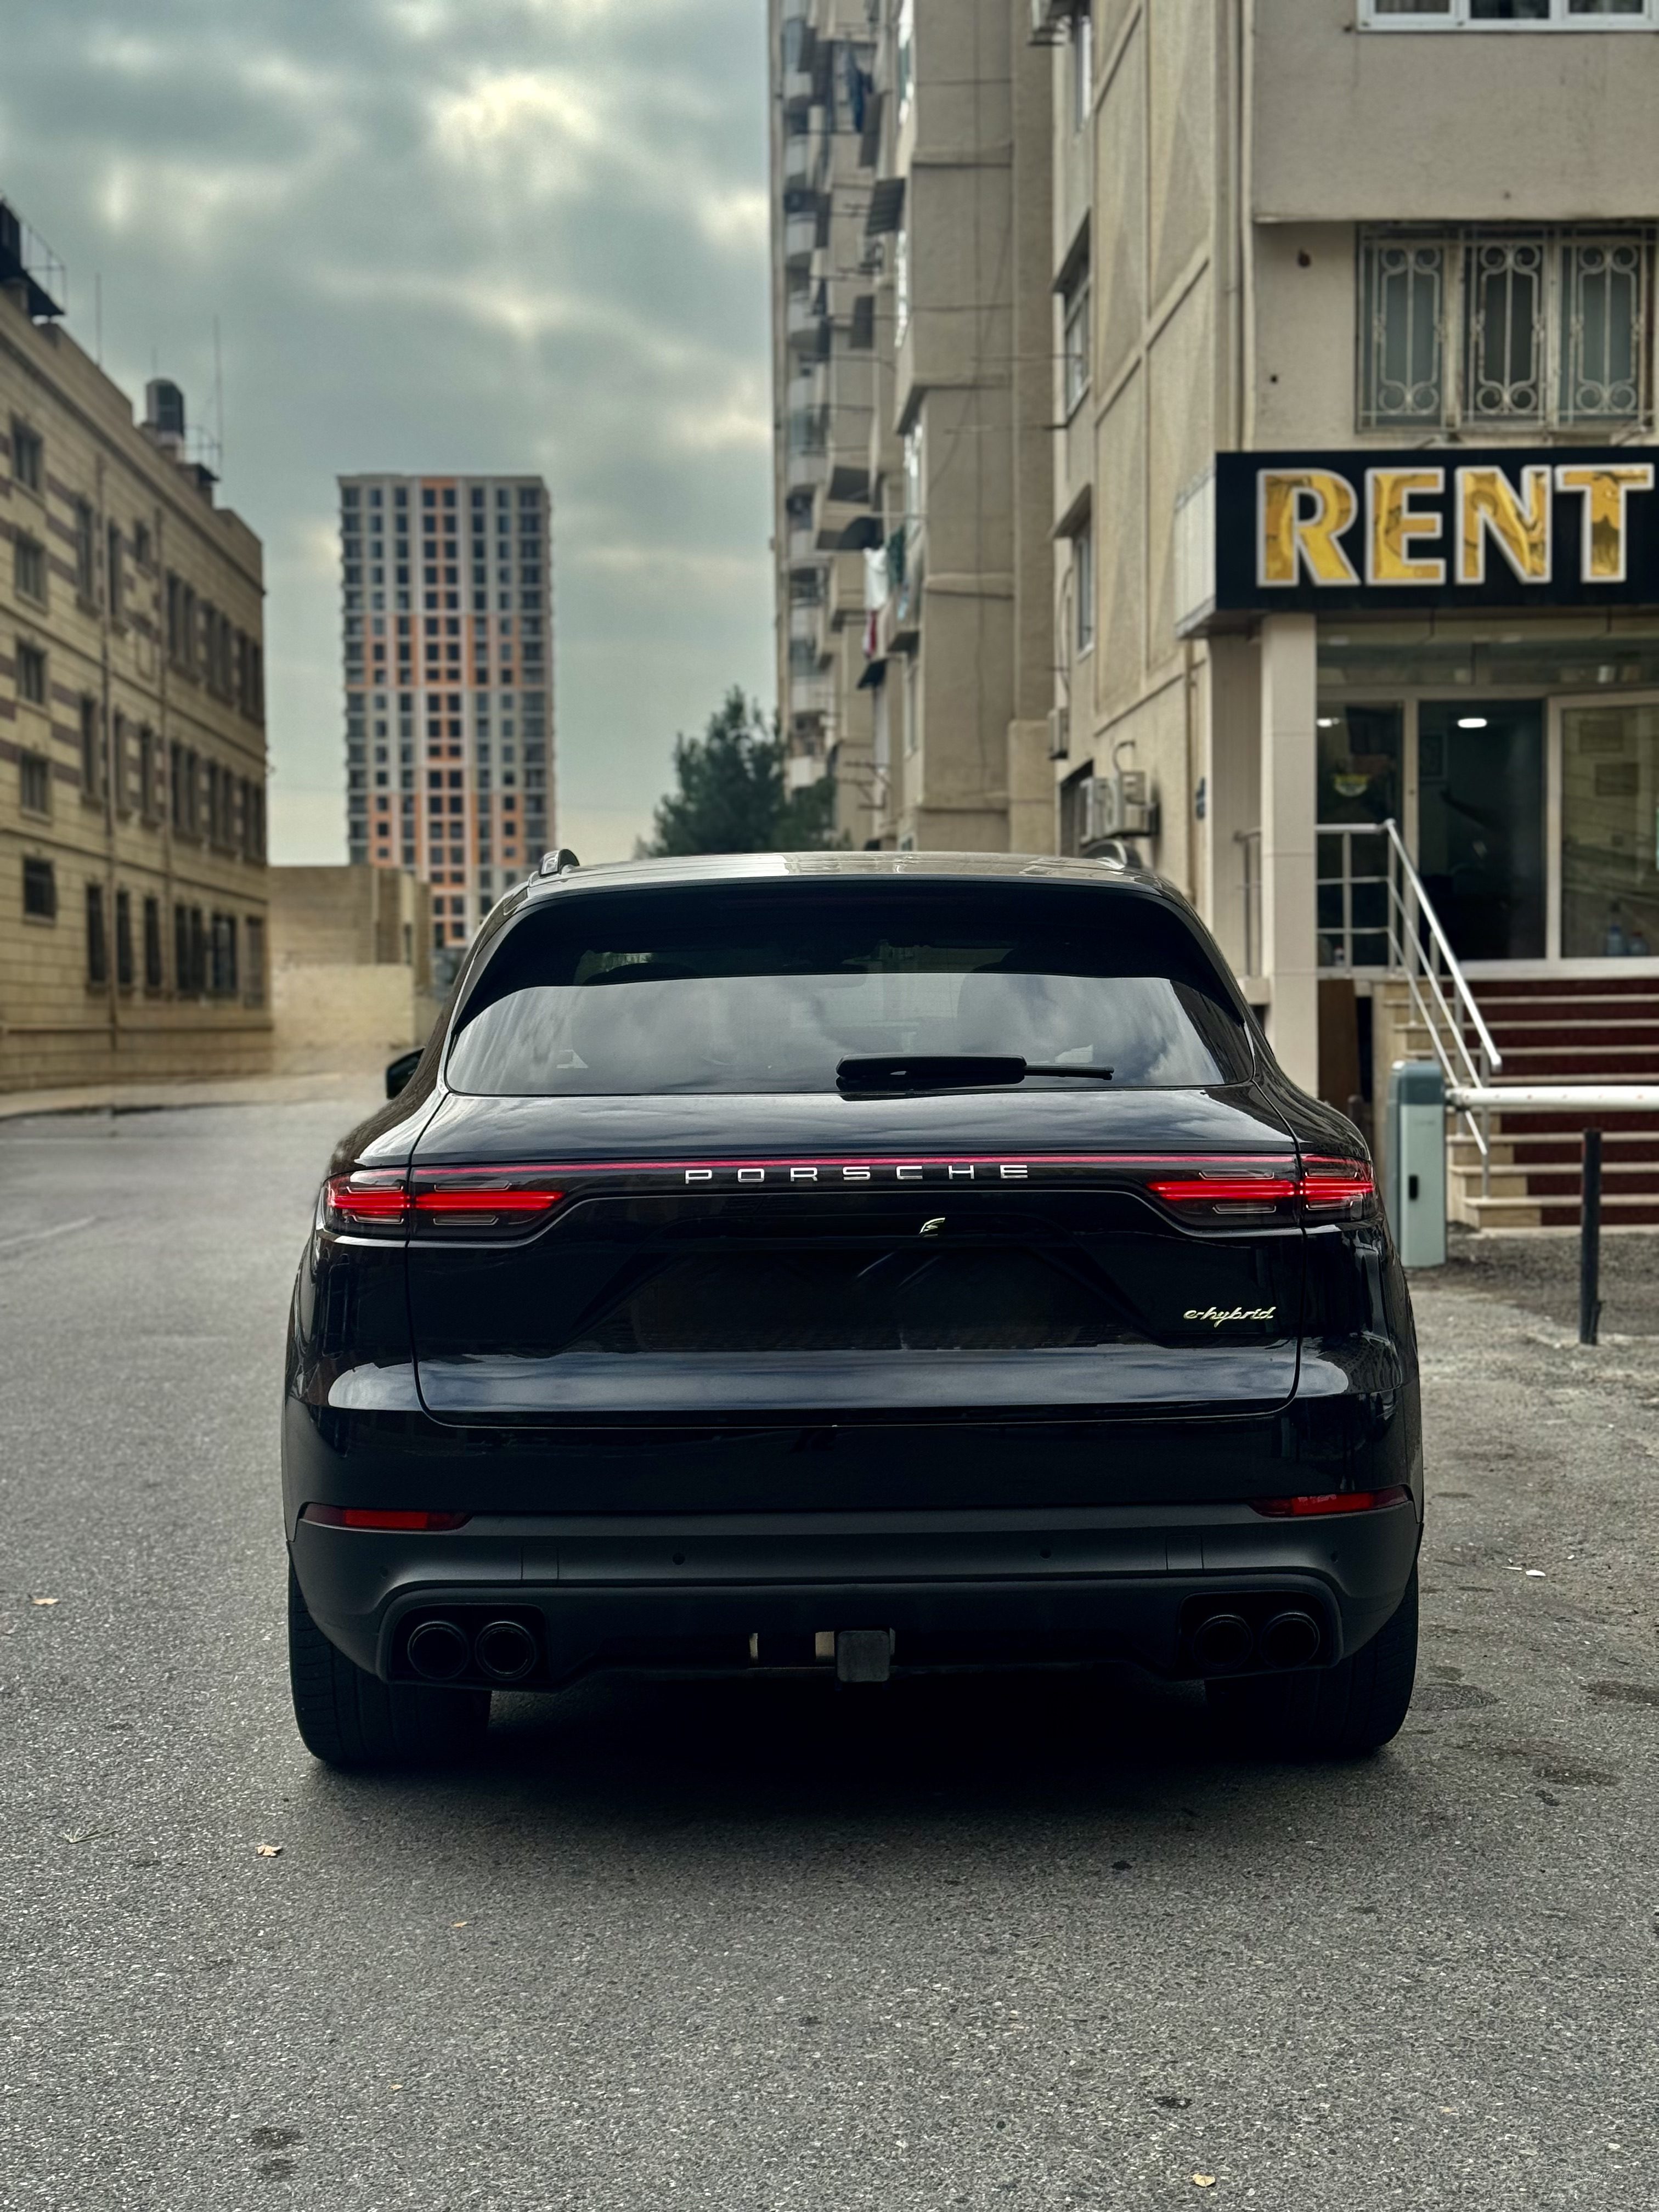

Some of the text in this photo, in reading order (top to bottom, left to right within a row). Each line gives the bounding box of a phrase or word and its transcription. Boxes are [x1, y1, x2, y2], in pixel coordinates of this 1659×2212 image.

[1256, 463, 1655, 588] RENT
[685, 1165, 1028, 1184] PORSCHE
[1183, 1306, 1277, 1328] e-hybrid
